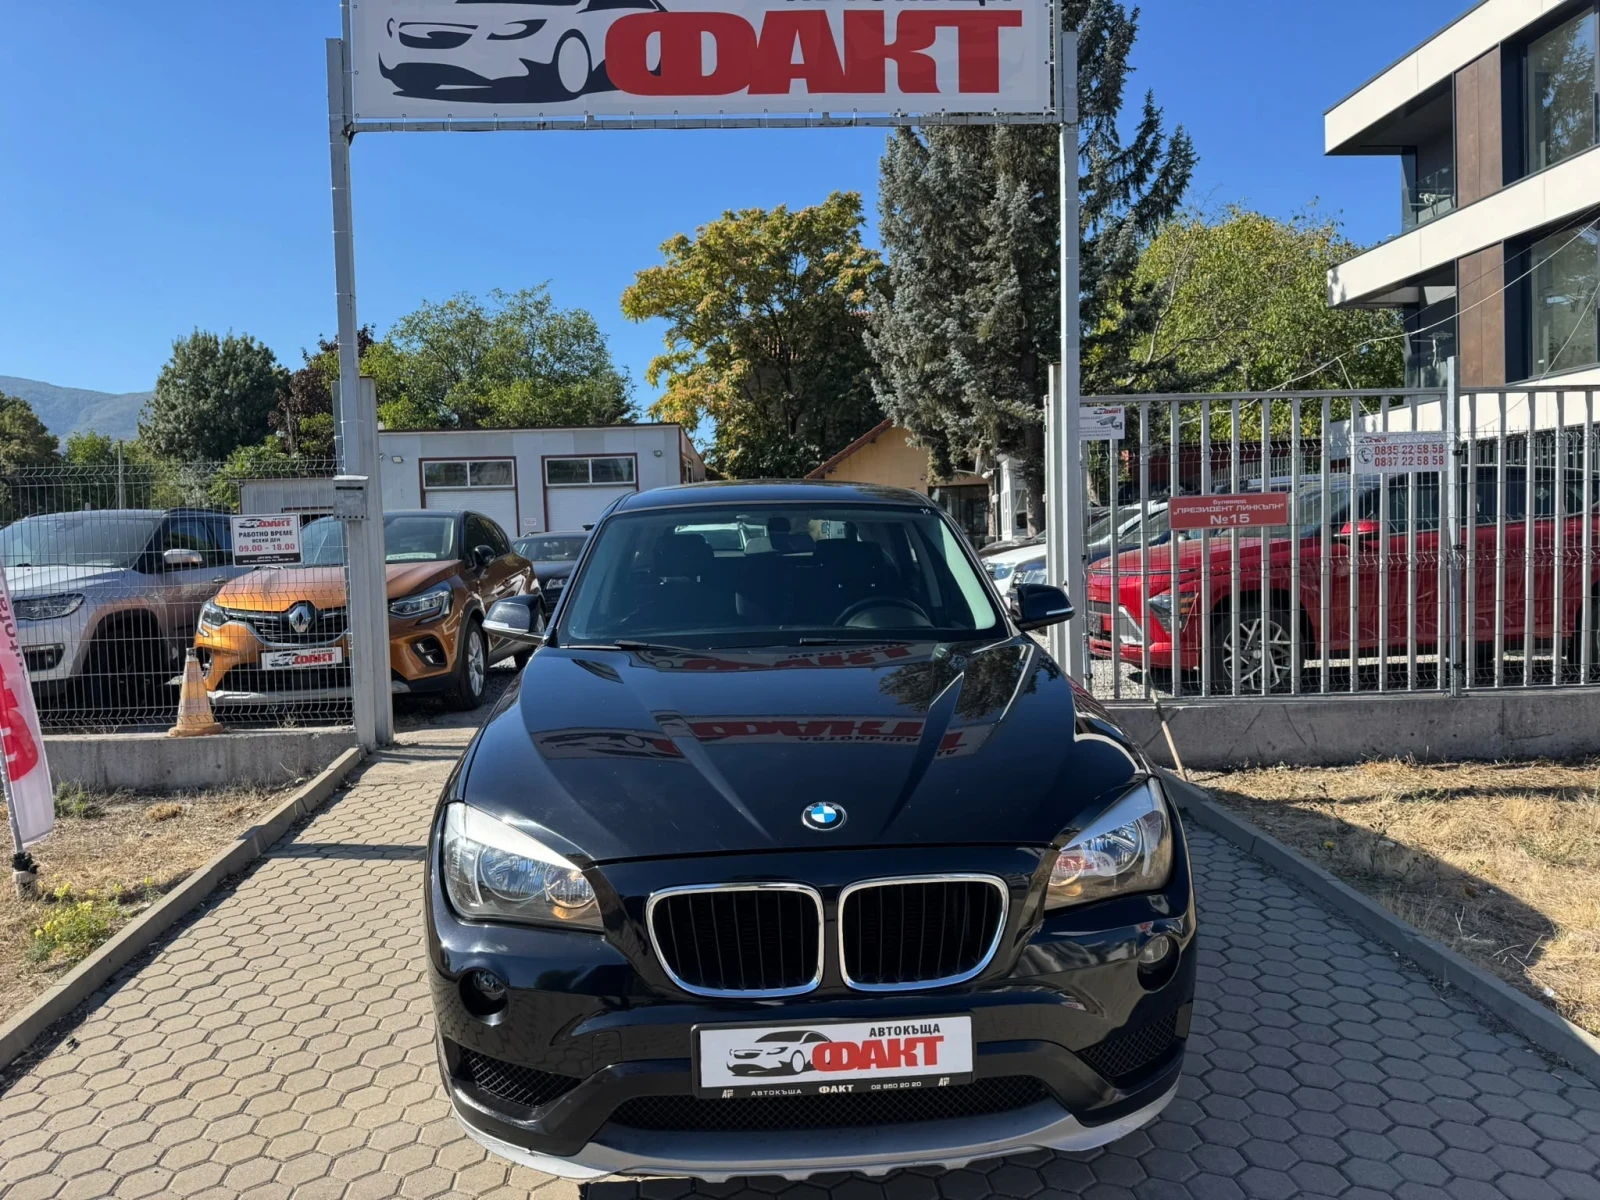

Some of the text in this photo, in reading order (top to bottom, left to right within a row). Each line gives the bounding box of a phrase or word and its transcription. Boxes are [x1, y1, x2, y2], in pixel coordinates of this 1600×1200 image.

[605, 9, 1022, 96] ФАКТ
[1402, 445, 1414, 454] 22
[1417, 444, 1429, 454] 58
[1432, 444, 1444, 453] 58
[1402, 456, 1414, 466] 22
[1417, 456, 1429, 465] 58
[1432, 455, 1444, 465] 58
[238, 530, 269, 538] РАБОТНО
[272, 543, 296, 551] 18.00
[869, 1023, 941, 1038] АВТОКЪЩА
[812, 1036, 944, 1072] ФАКТ
[819, 1084, 855, 1094] ФАКТ
